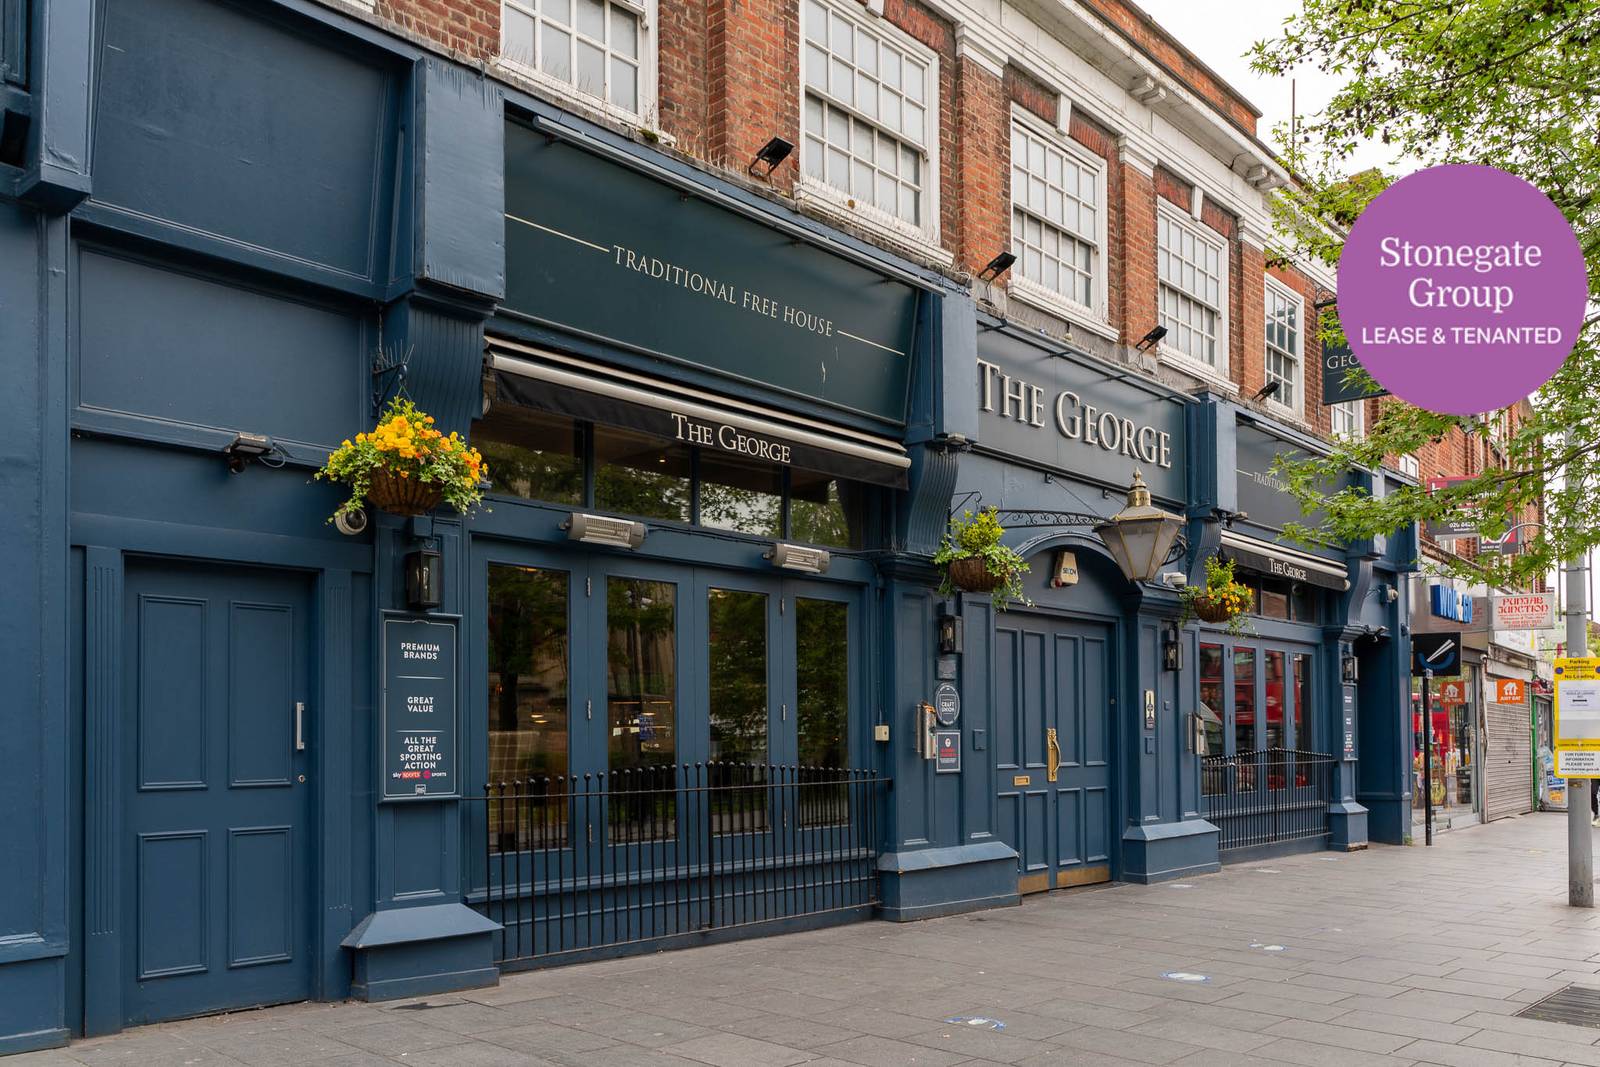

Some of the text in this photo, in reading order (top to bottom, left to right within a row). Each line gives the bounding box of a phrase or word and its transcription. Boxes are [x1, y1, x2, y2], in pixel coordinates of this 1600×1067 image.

[613, 244, 833, 336] TRADITIONAL FREE HOUSE
[1327, 353, 1360, 369] GEO
[977, 358, 1171, 469] THE GEORGE
[671, 413, 791, 463] THE GEORGE
[1283, 562, 1307, 581] GEORGE
[1502, 597, 1544, 606] PUNJAB
[1498, 605, 1549, 614] JUNCTION
[401, 642, 441, 652] PREMIUM
[403, 651, 438, 660] BRANDS
[407, 696, 434, 704] GREAT
[420, 736, 437, 744] THE
[400, 753, 442, 761] SPORTING
